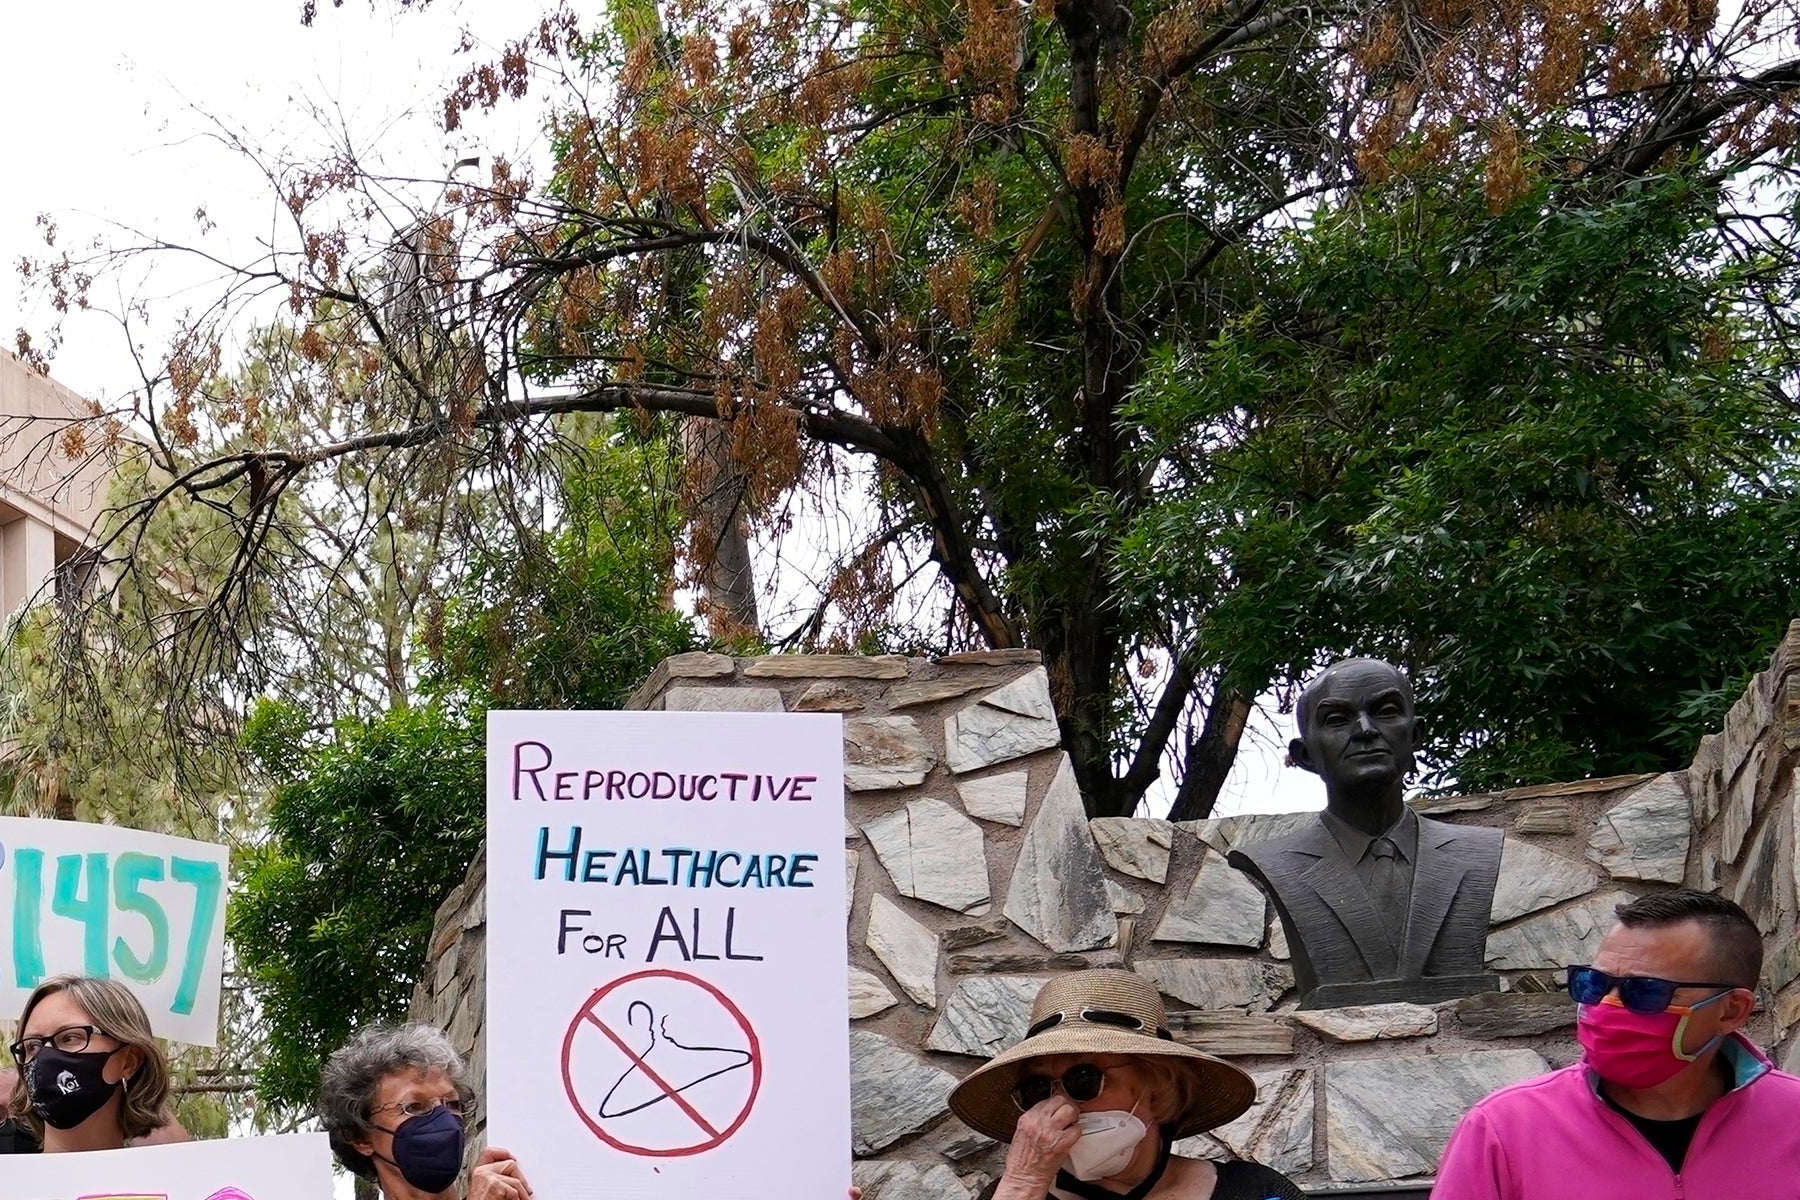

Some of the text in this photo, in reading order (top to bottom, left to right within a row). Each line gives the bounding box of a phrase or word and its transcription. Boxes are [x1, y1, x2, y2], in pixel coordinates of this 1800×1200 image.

[512, 741, 818, 803] REPRODUCTIVE
[534, 826, 819, 889] HEALTHCARE
[12, 847, 221, 1016] 1457
[645, 906, 764, 963] ALL
